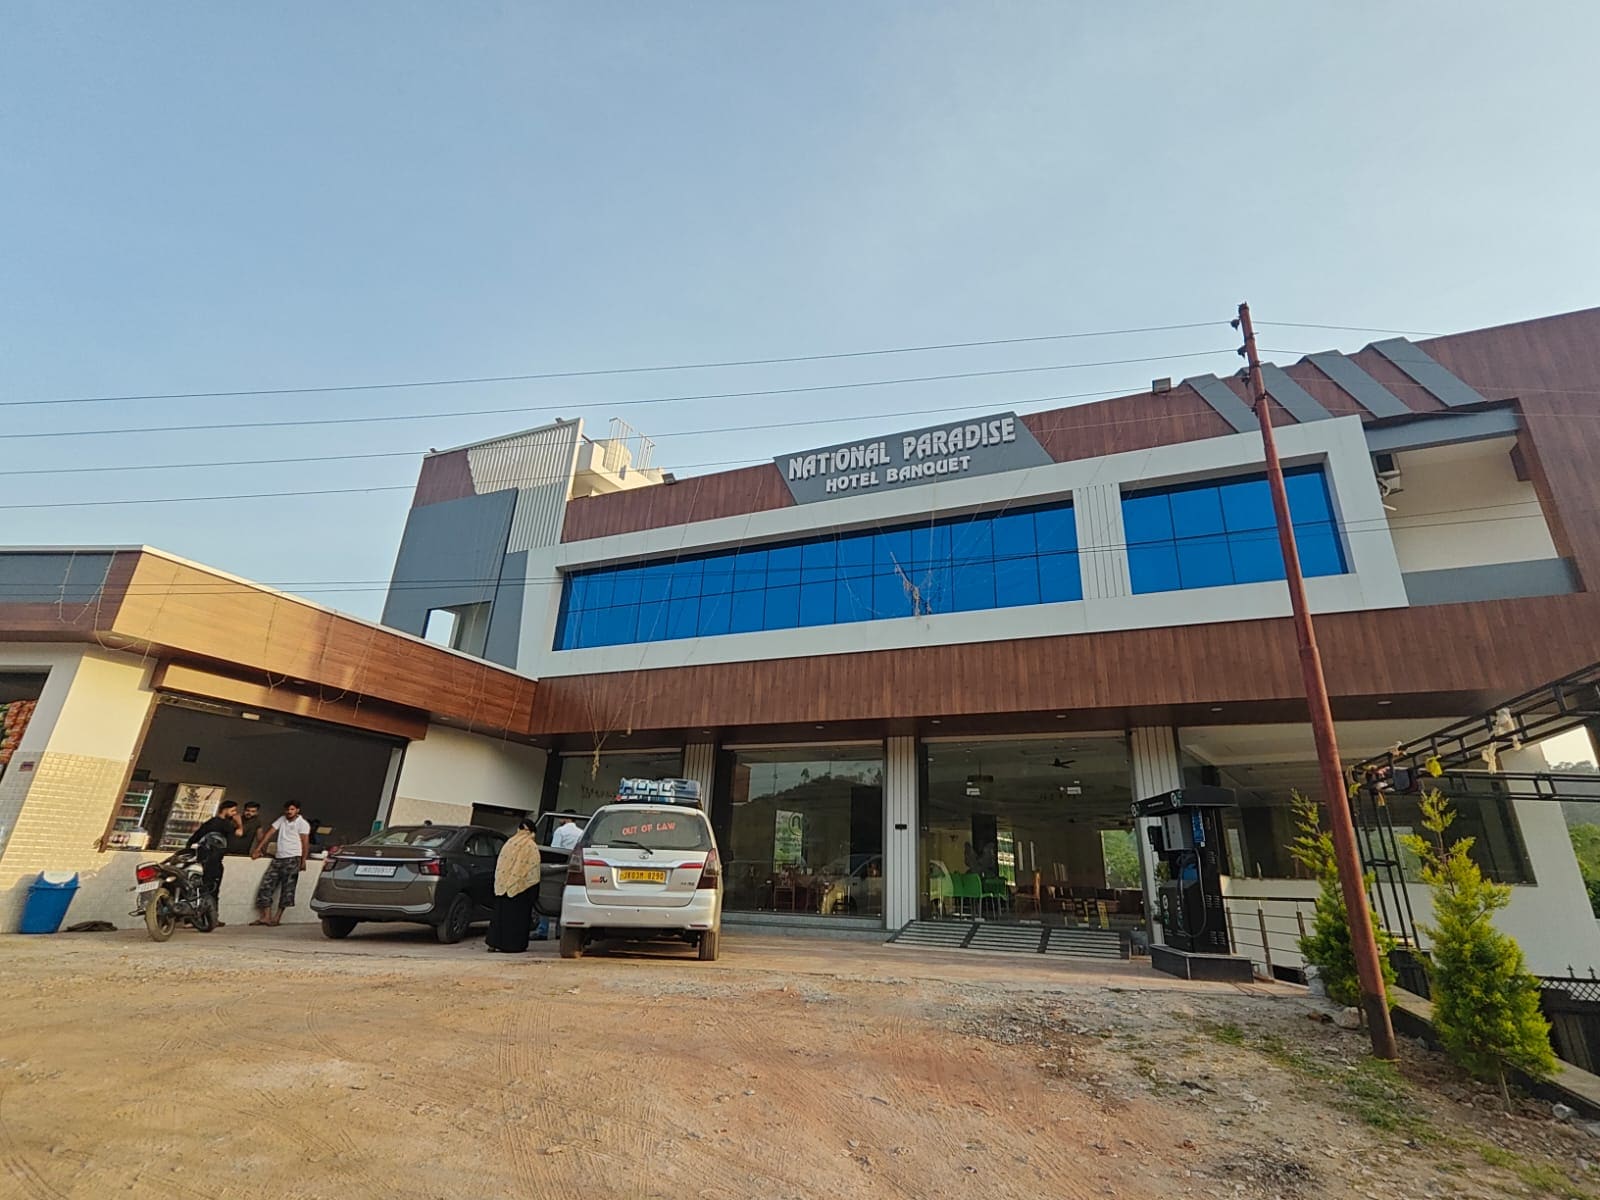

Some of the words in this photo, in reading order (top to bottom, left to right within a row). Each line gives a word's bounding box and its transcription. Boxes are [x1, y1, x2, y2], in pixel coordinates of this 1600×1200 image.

[788, 441, 890, 480] NATIONAL
[902, 417, 1016, 460] PARADISE
[825, 471, 879, 493] HOTEL
[886, 456, 971, 484] BANQUET
[622, 825, 638, 836] OUT
[641, 823, 653, 833] OF
[656, 821, 676, 832] LAW
